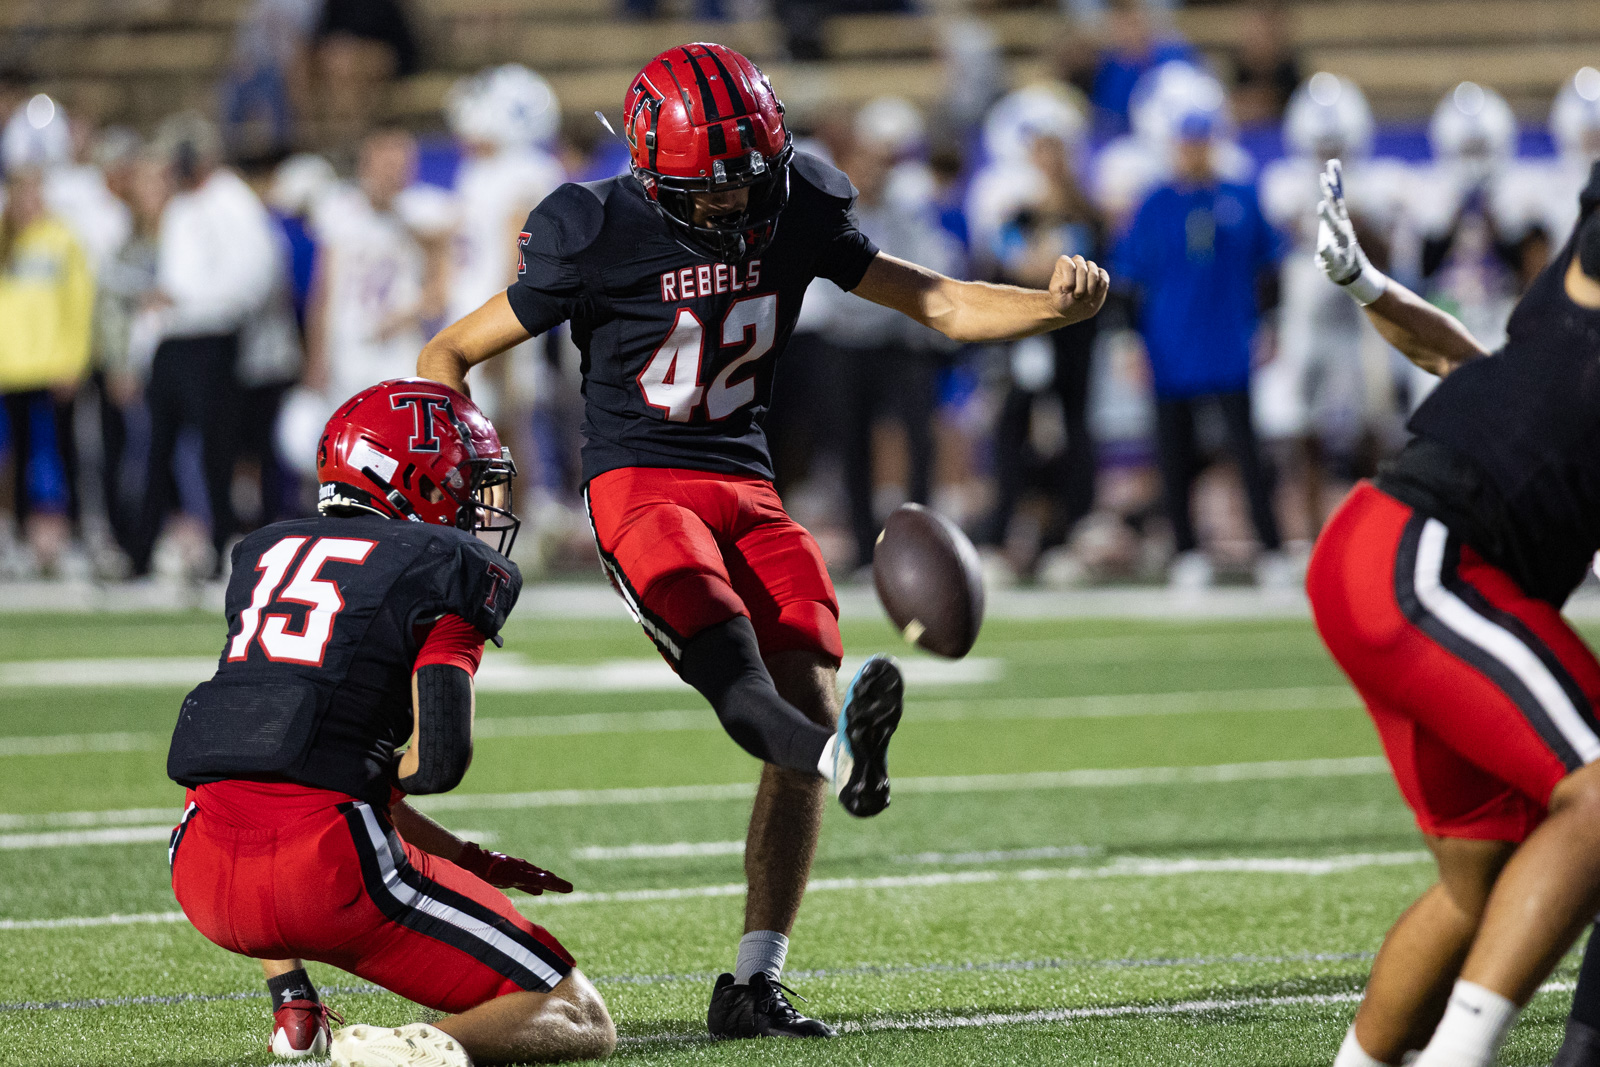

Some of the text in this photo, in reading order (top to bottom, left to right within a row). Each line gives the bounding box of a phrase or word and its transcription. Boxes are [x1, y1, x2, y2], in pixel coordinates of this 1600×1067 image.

[626, 72, 666, 149] T
[660, 259, 761, 302] REBELS
[636, 291, 779, 422] 42
[389, 392, 450, 452] T
[227, 535, 380, 667] 15
[484, 561, 511, 614] T
